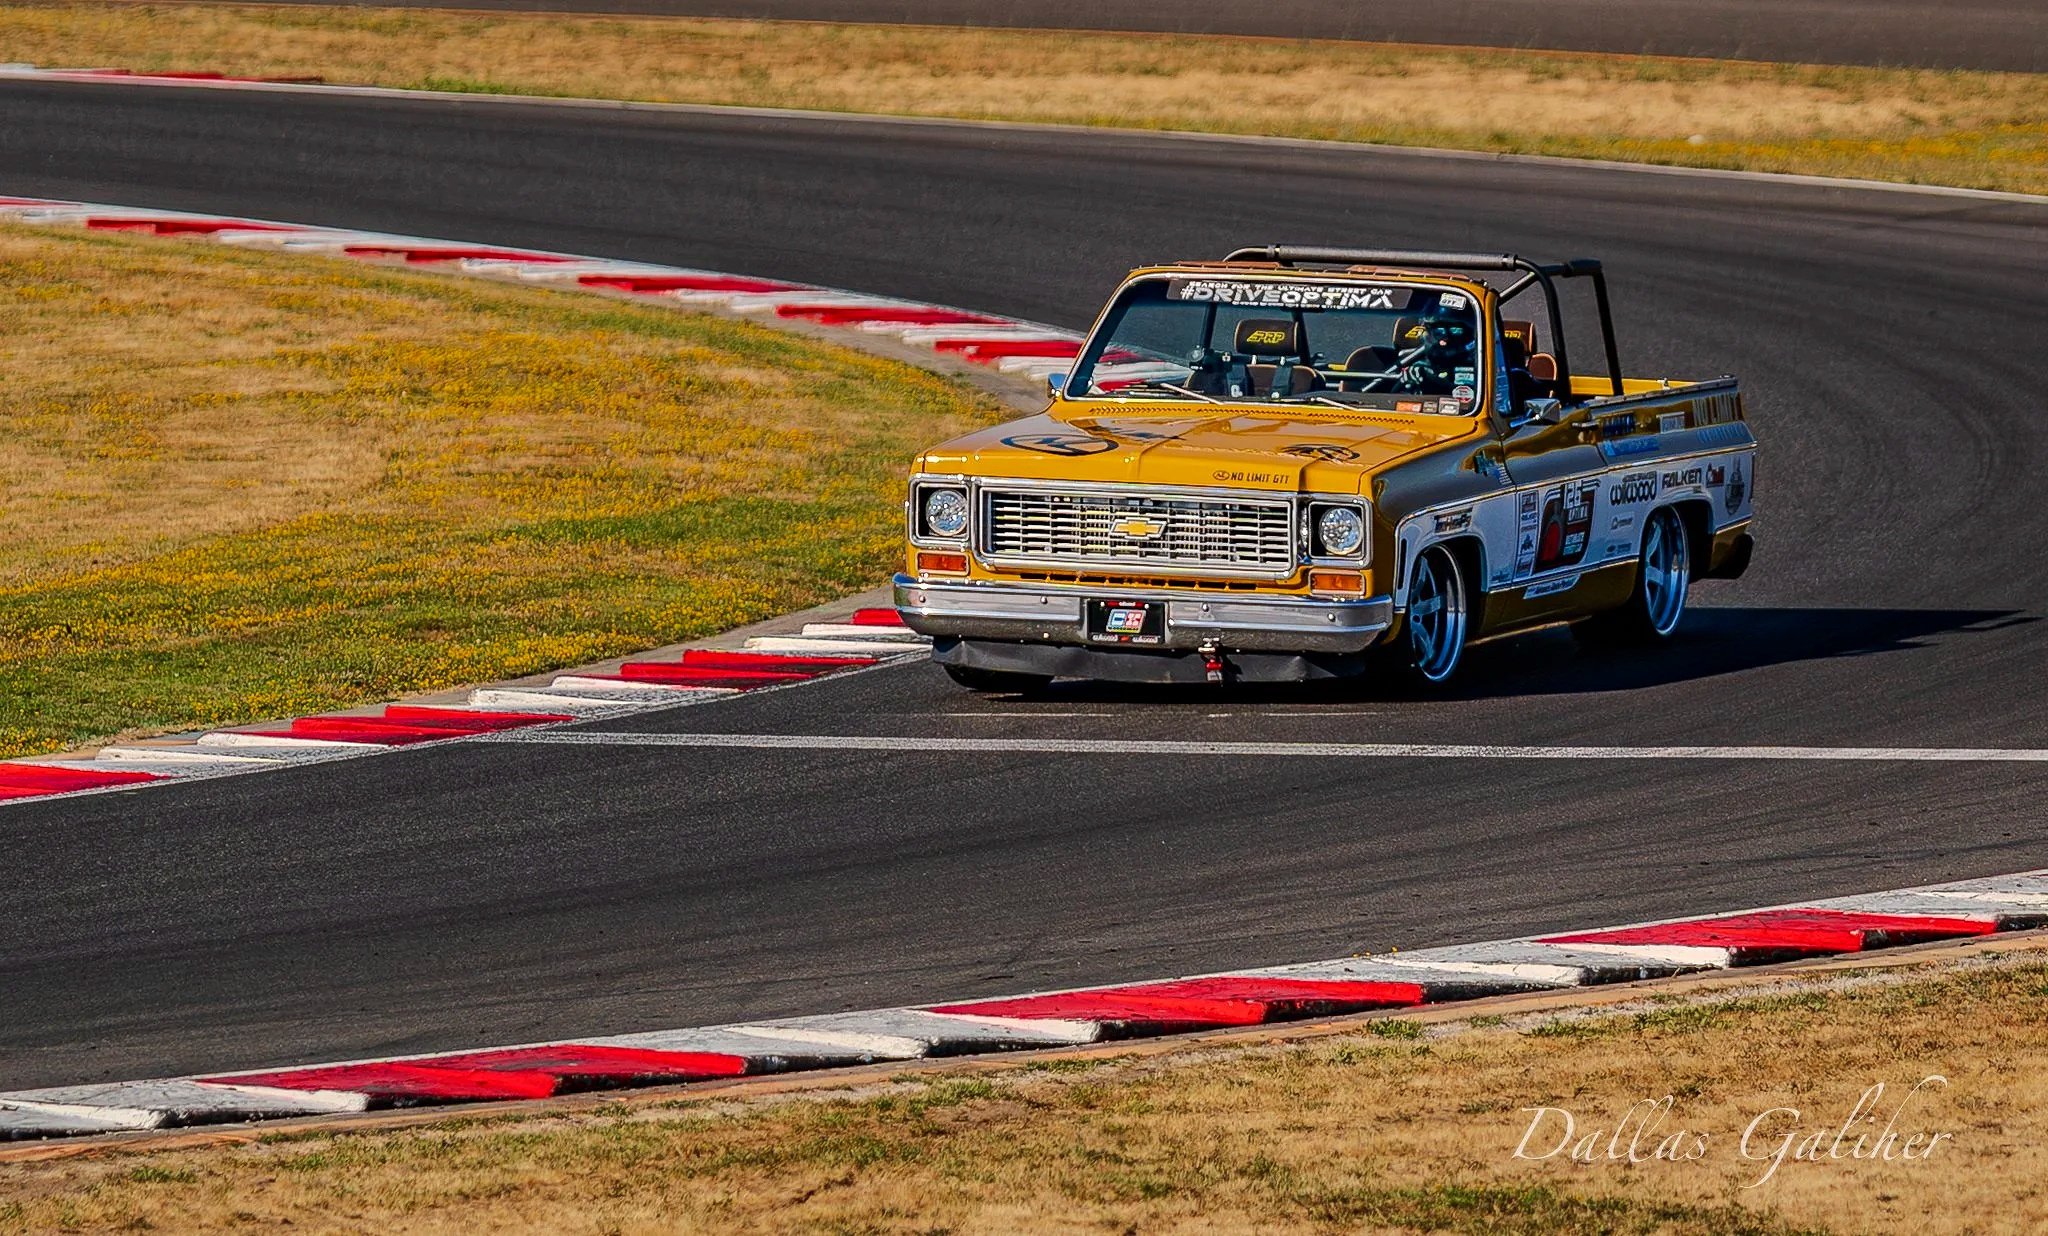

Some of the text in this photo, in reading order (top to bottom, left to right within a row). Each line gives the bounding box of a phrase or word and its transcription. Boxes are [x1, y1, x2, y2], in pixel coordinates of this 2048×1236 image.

[1180, 285, 1393, 309] #DRIVEOPTIMA
[1188, 281, 1229, 289] SEARCH
[1277, 285, 1324, 293] ULTIMATE
[1370, 288, 1393, 296] CAR
[1231, 472, 1244, 481] NO
[1246, 472, 1271, 483] LIMIT
[1662, 468, 1702, 489] FALKEN
